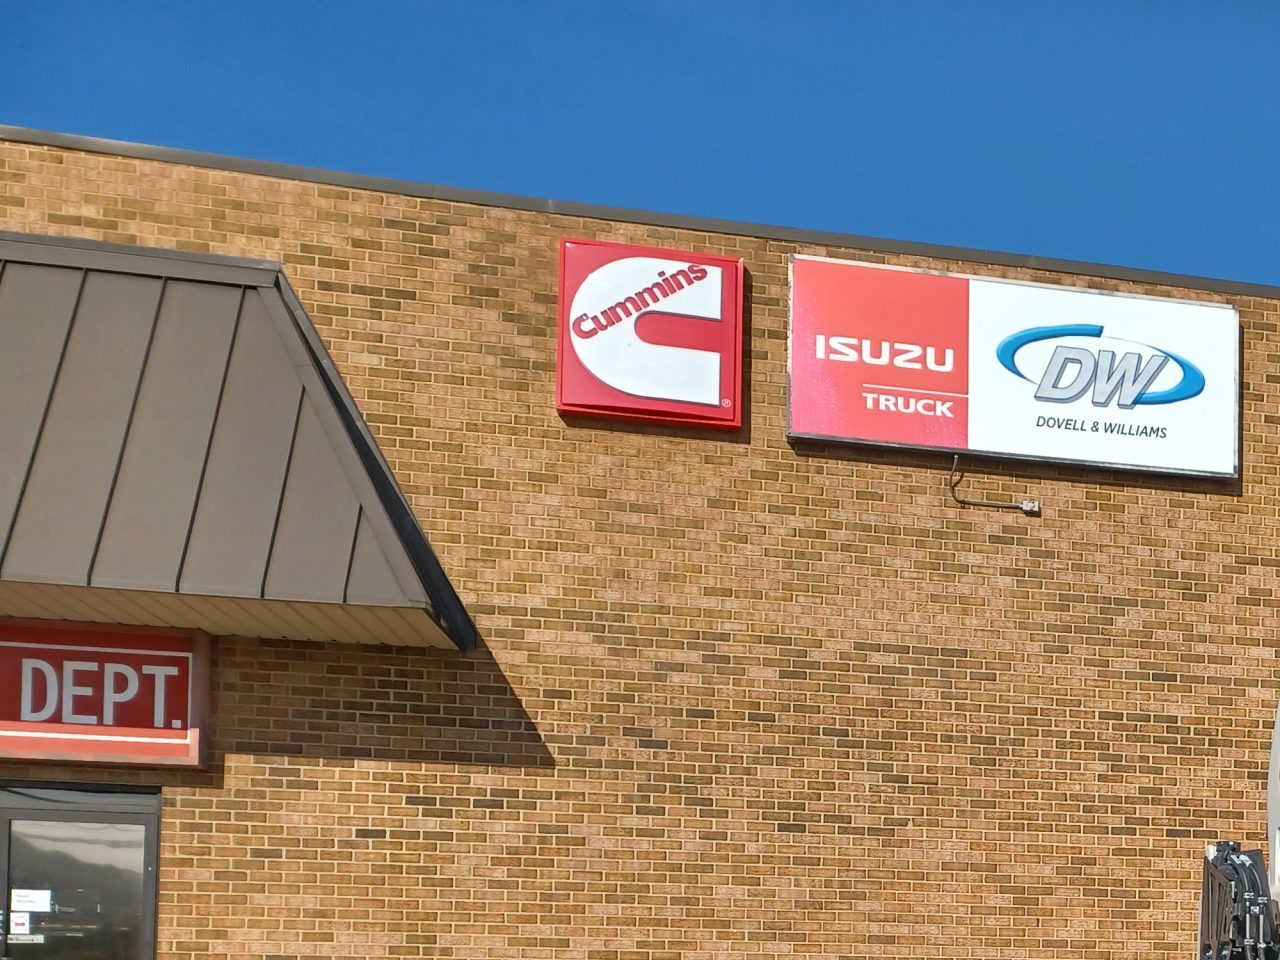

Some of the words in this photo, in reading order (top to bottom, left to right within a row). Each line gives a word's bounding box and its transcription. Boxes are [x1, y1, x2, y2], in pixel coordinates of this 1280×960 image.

[572, 264, 708, 339] Cummins
[815, 334, 954, 372] ISUZU
[1033, 345, 1170, 410] DW
[862, 392, 954, 418] TRUCK
[1036, 415, 1087, 432] DOVELL
[1090, 421, 1100, 433] &
[1104, 422, 1168, 439] WILLIAMS
[20, 658, 182, 729] DEPT.
